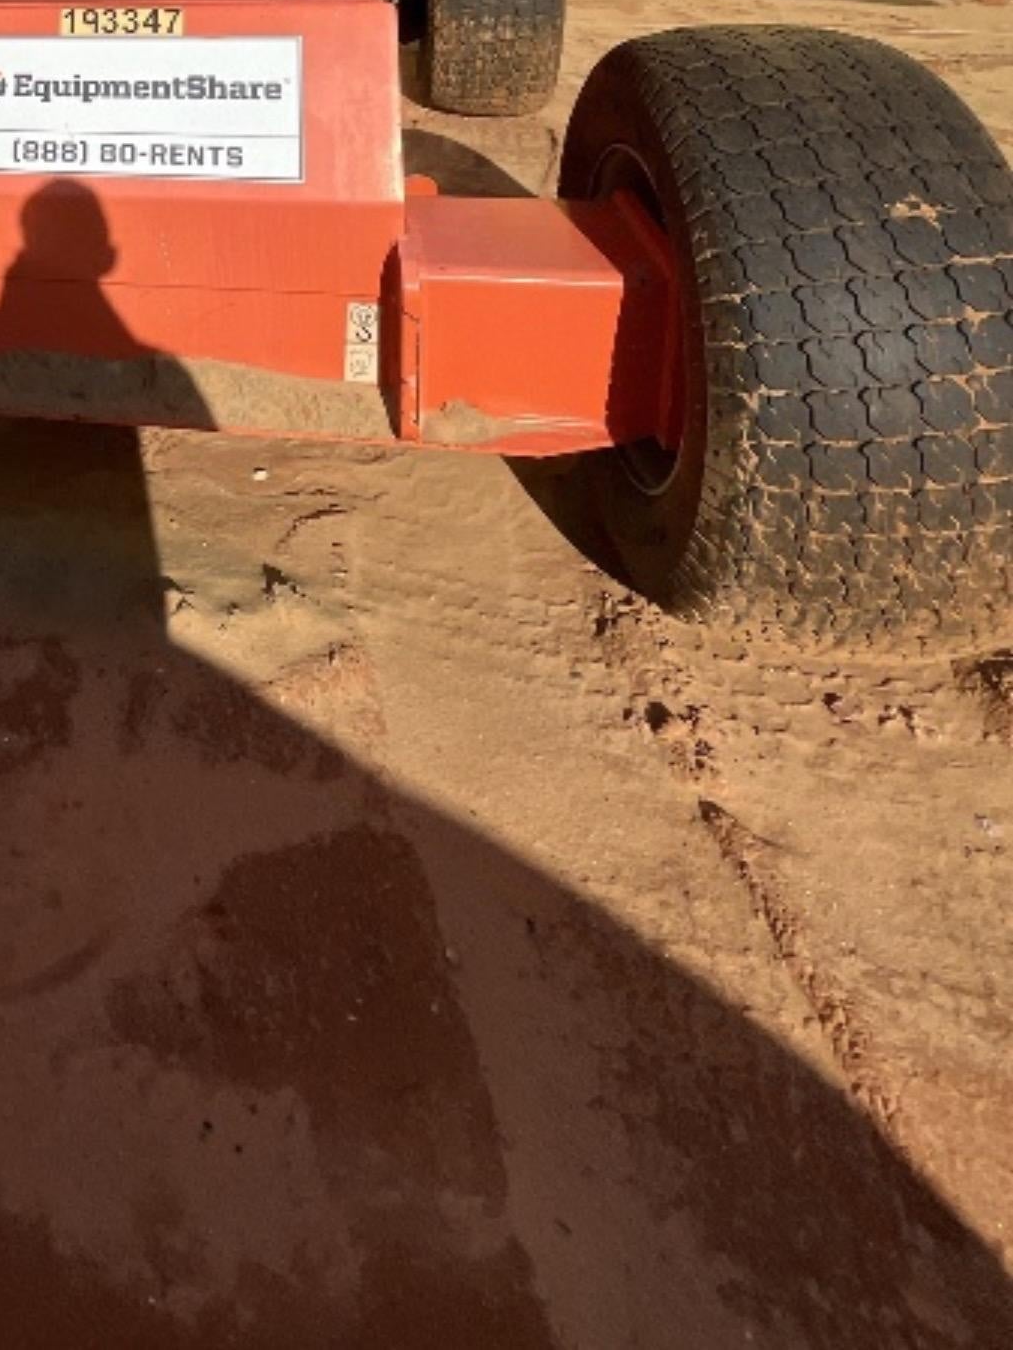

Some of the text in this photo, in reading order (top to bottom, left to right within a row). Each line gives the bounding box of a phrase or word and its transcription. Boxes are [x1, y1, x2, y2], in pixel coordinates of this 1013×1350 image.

[63, 8, 182, 35] 193347
[13, 73, 283, 103] EquipmentShare
[13, 138, 88, 165] (888)
